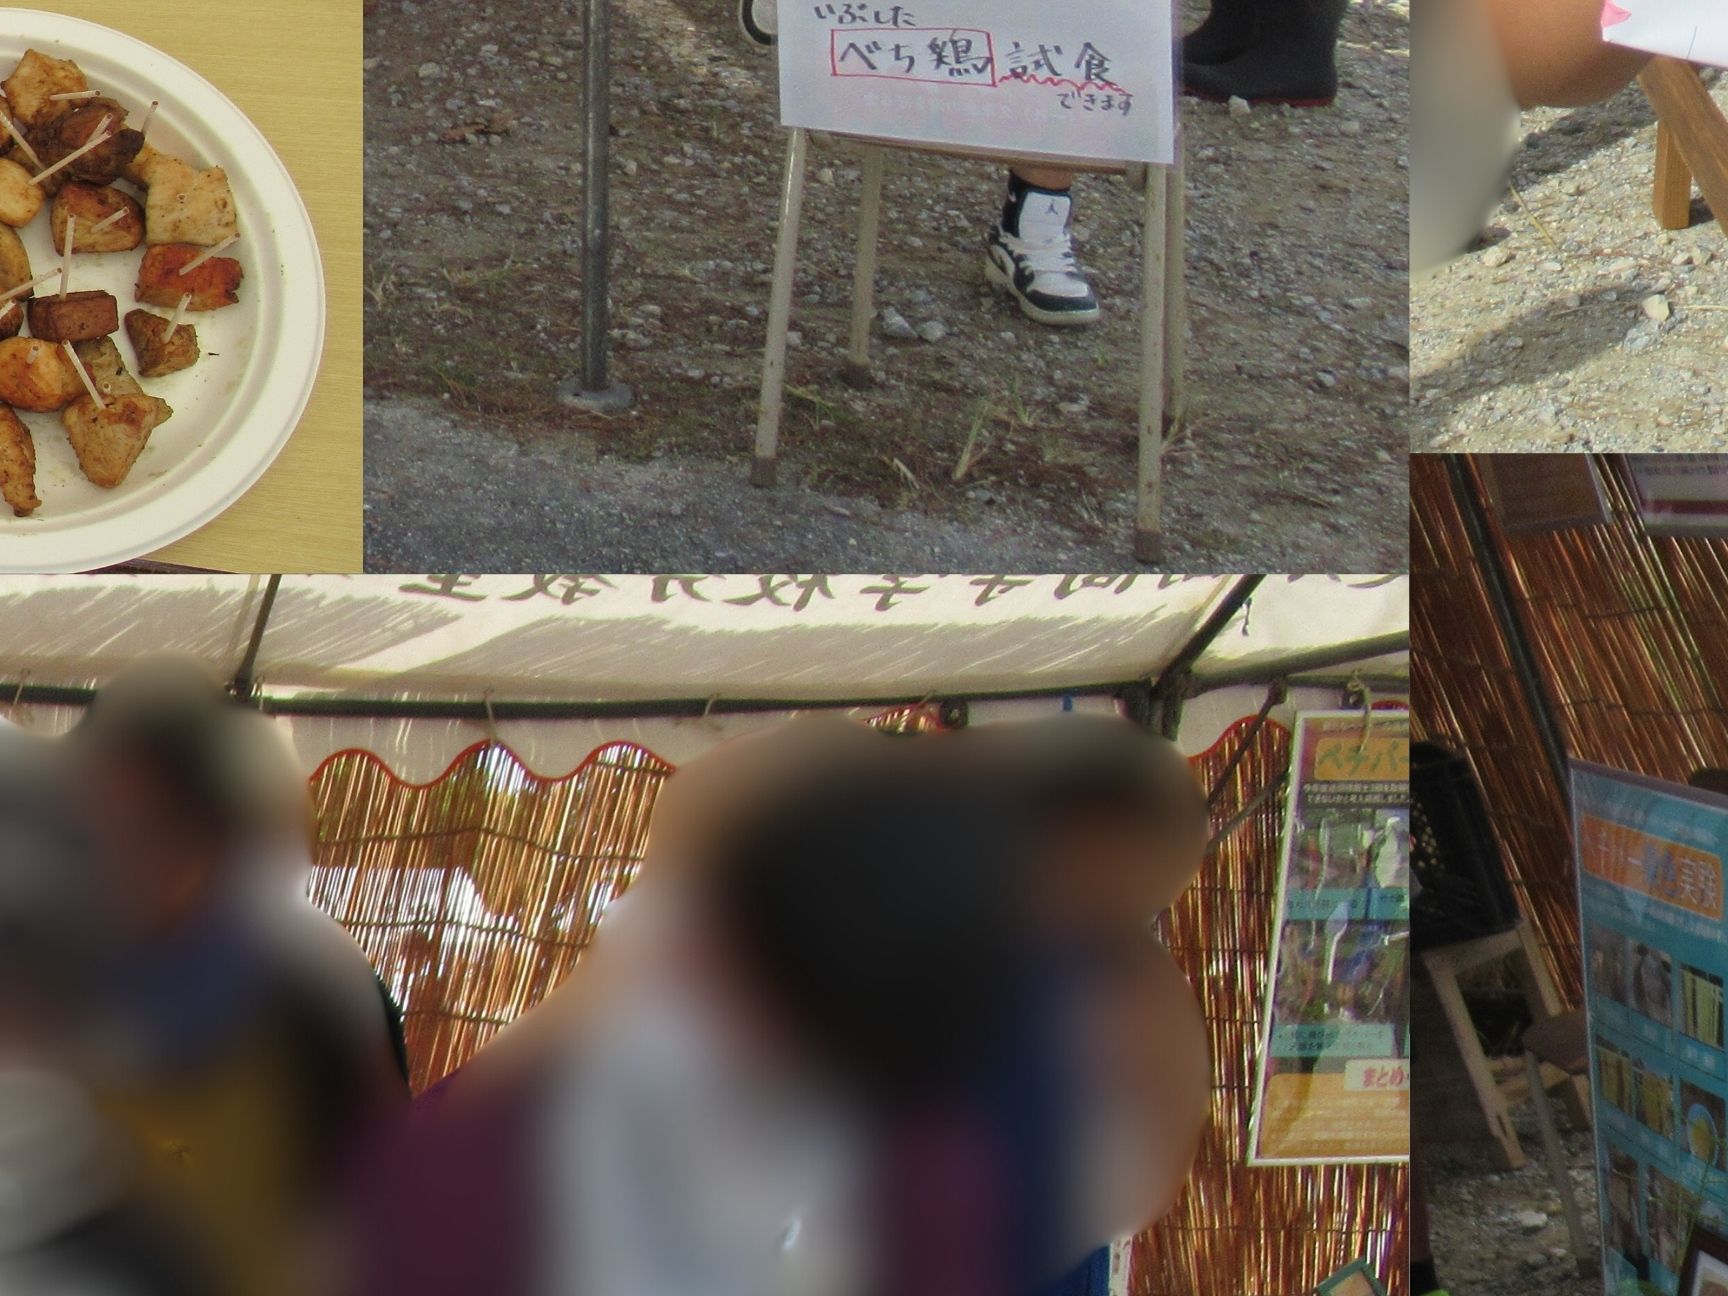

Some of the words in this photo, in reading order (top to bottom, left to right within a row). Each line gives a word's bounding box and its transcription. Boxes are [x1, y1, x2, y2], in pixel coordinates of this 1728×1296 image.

[814, 3, 917, 27] いぶした
[1005, 40, 1120, 85] 試食
[1057, 91, 1134, 116] できます
